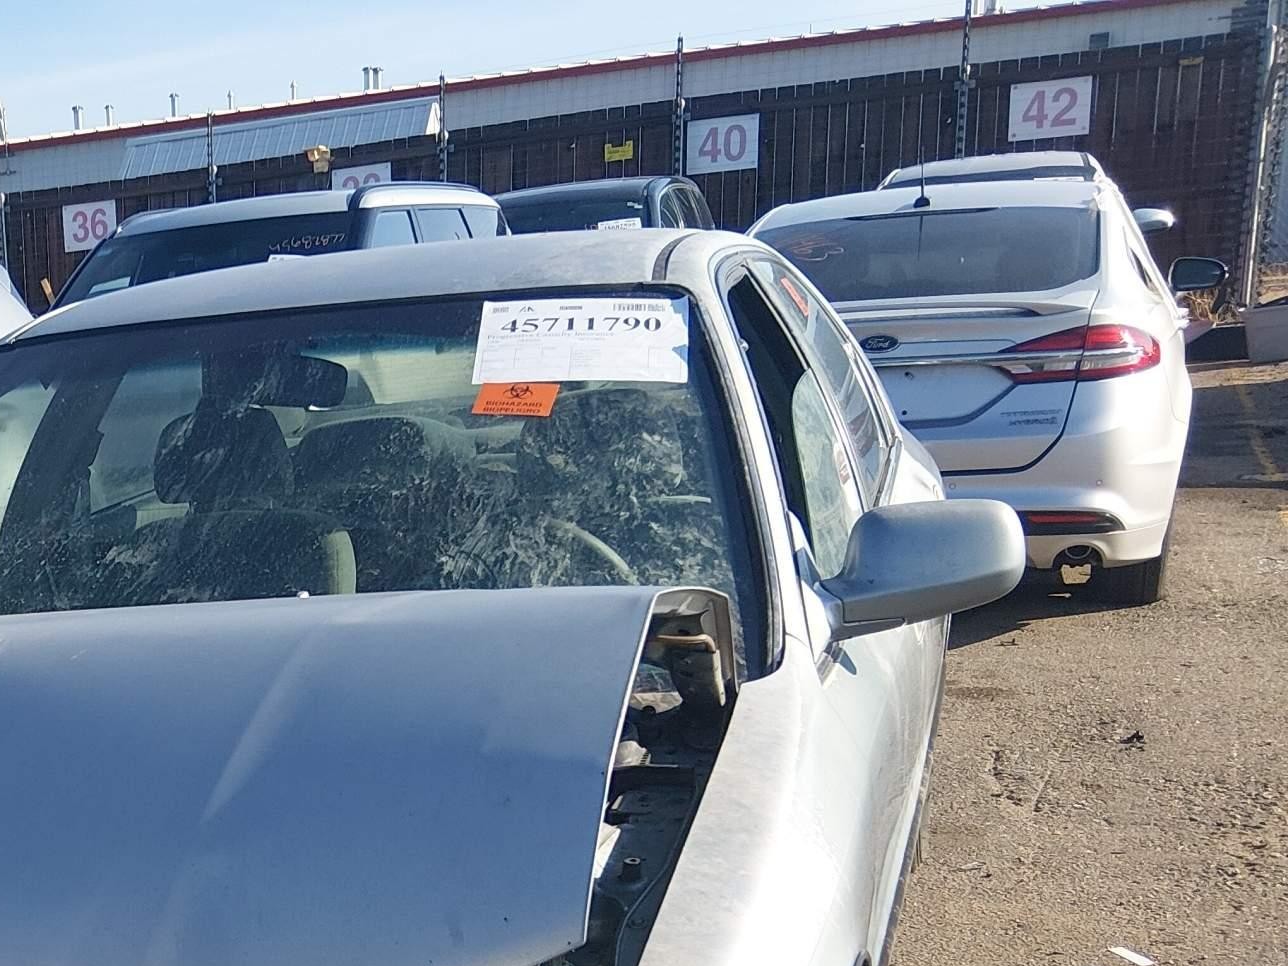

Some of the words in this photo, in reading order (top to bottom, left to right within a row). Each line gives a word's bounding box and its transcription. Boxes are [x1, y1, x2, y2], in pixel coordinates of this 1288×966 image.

[1022, 87, 1078, 129] 42
[698, 124, 747, 163] 40
[72, 208, 108, 243] 36
[500, 316, 661, 333] 45711790
[865, 338, 890, 349] Ford
